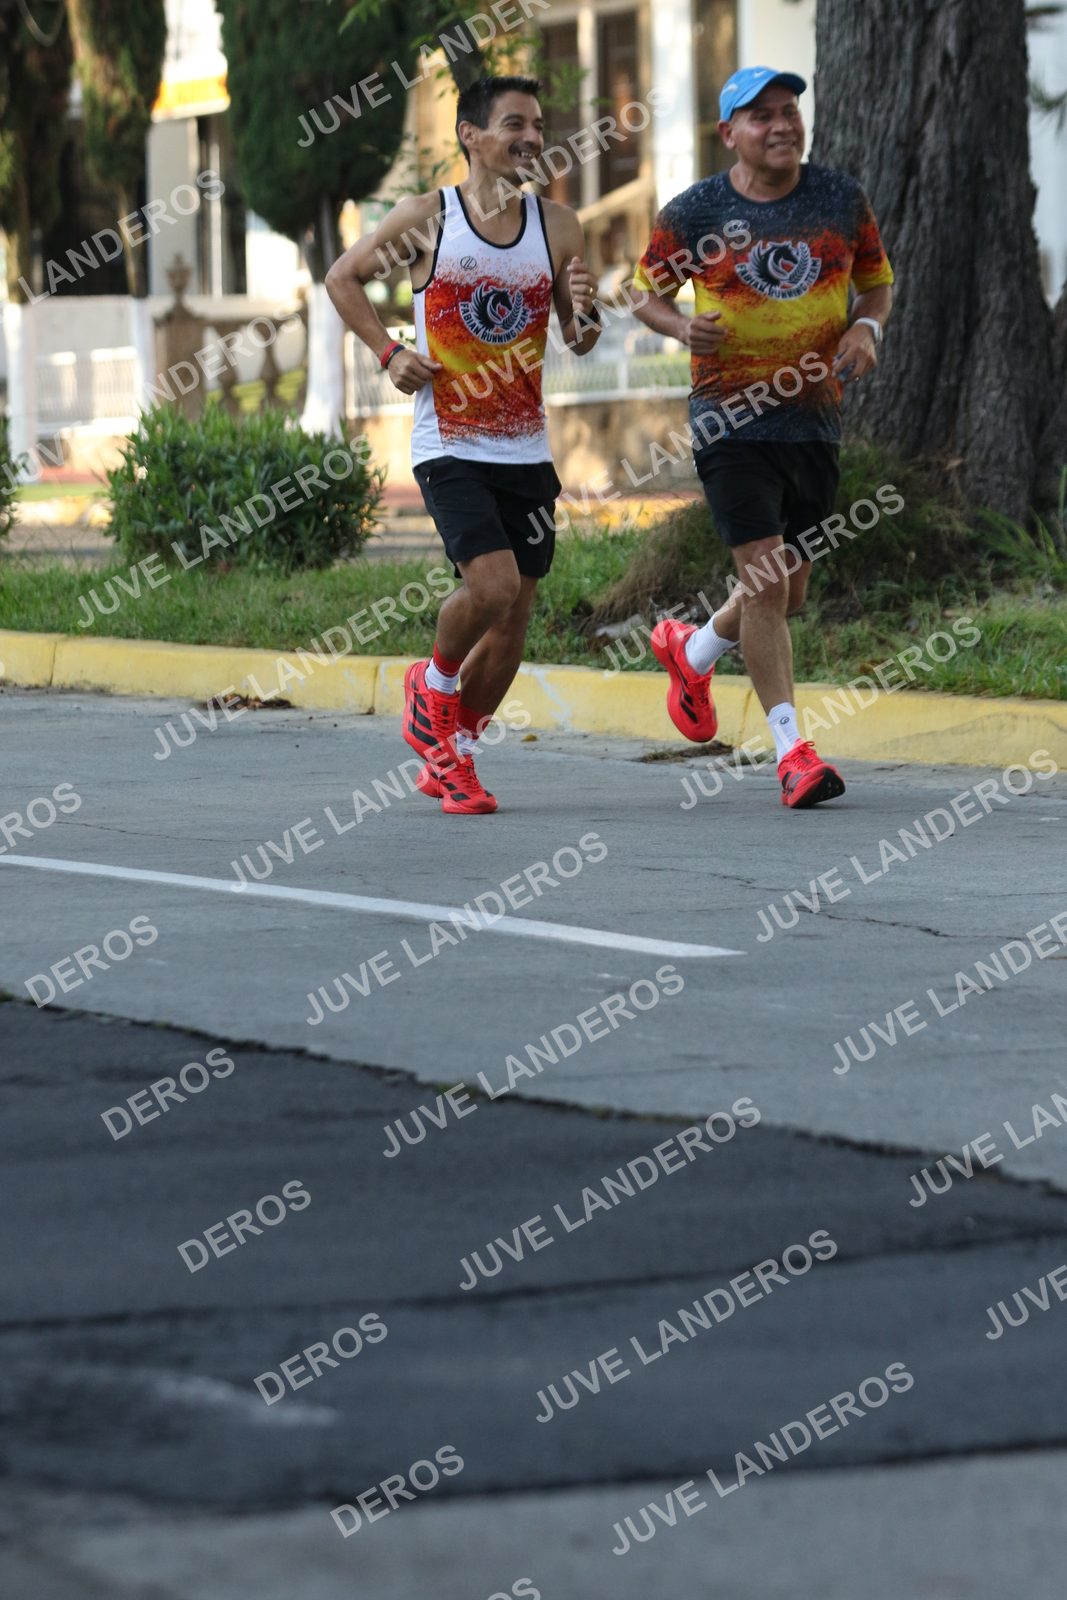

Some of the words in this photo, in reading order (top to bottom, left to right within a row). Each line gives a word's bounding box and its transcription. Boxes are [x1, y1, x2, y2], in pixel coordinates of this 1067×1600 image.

[461, 303, 481, 335] FABIAN
[481, 331, 517, 343] RUNNING
[515, 308, 529, 332] TEAM
